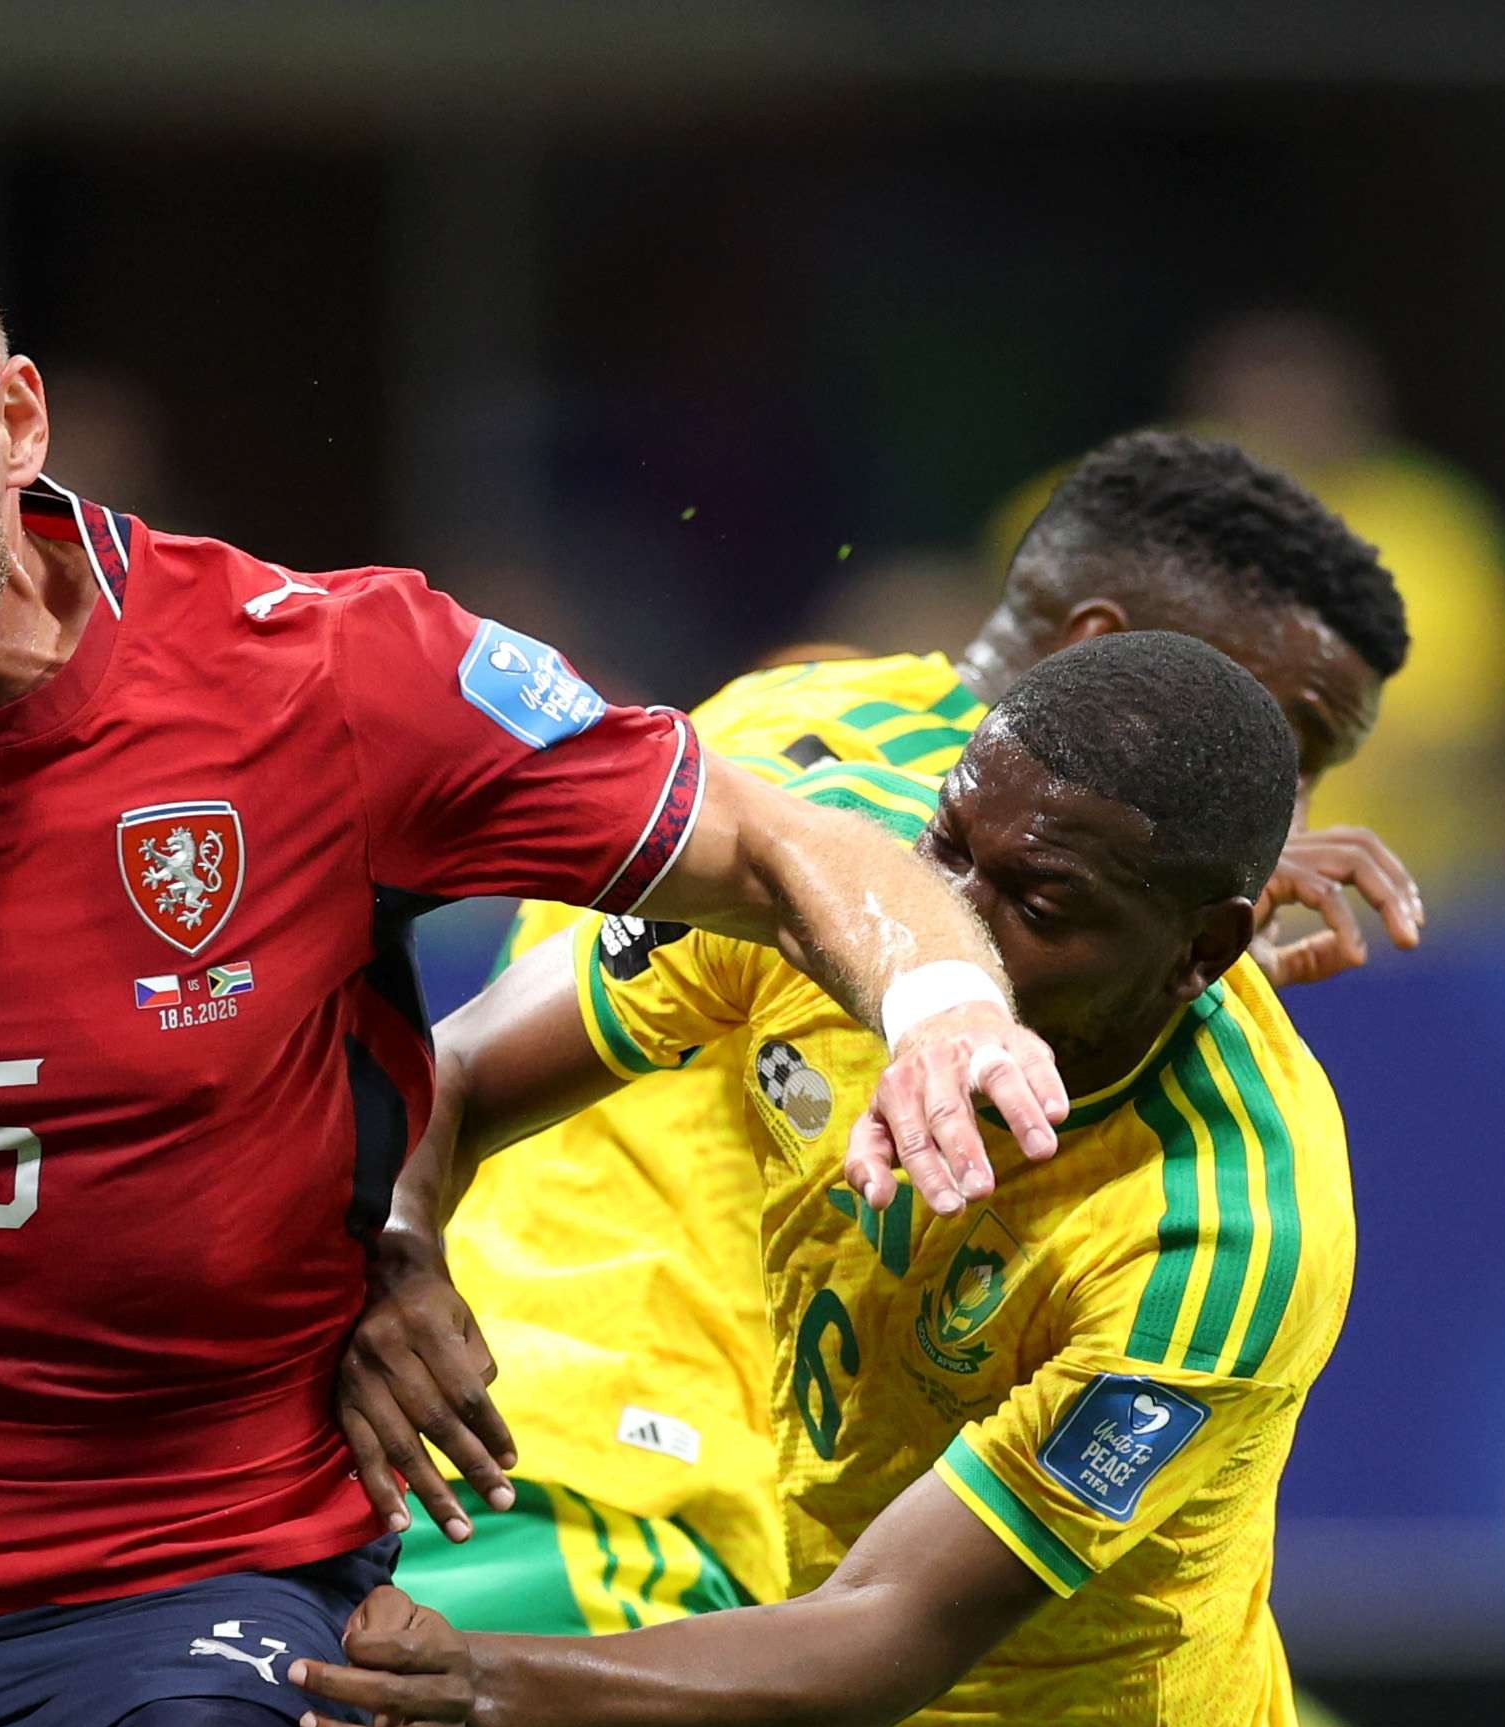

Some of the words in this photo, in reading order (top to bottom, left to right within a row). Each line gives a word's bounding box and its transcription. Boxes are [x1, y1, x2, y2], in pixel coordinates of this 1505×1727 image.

[158, 998, 238, 1031] 18.6.2026
[794, 1288, 861, 1461] 6
[1093, 1418, 1134, 1455] Unite
[1079, 1468, 1110, 1497] FIFA
[1080, 1440, 1136, 1488] PEACE
